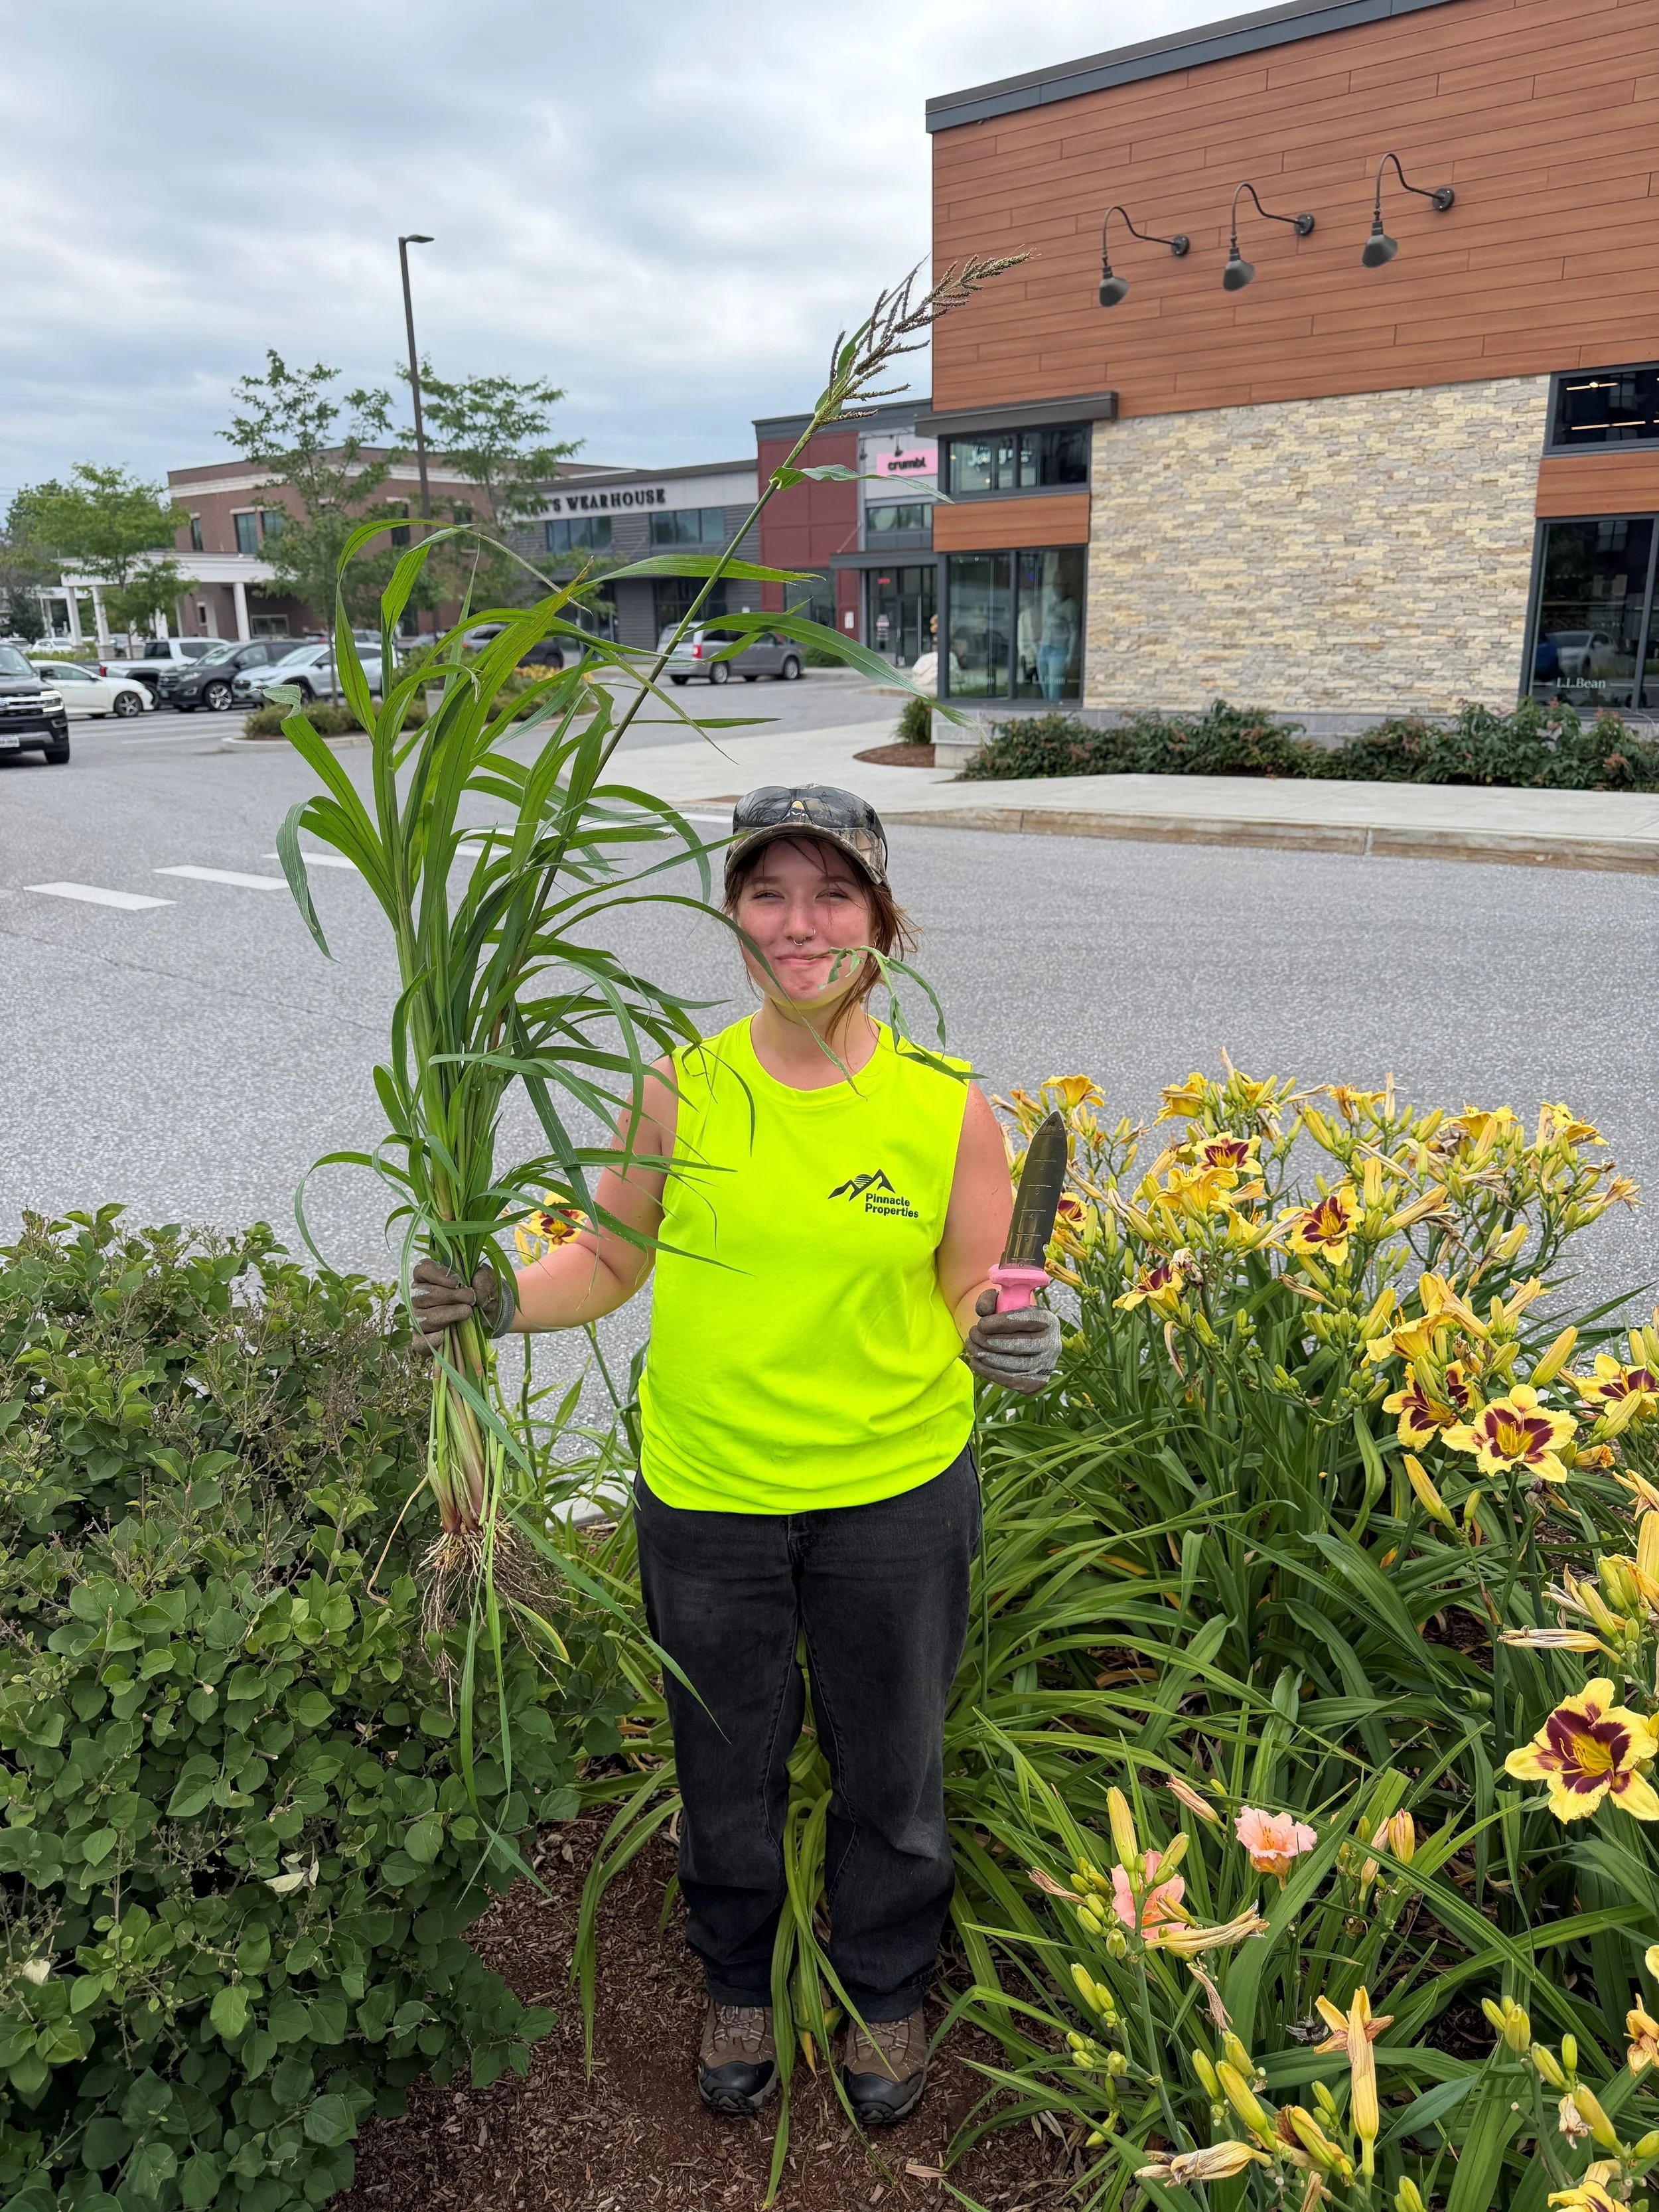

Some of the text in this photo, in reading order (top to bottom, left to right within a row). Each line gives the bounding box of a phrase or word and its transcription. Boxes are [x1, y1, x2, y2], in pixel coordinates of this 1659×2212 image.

[887, 456, 926, 471] crumbl
[567, 488, 665, 510] WEARHOUSE
[1556, 676, 1606, 689] L.L.Bean
[865, 1193, 910, 1207] Pinnacle
[865, 1203, 918, 1218] Properties
